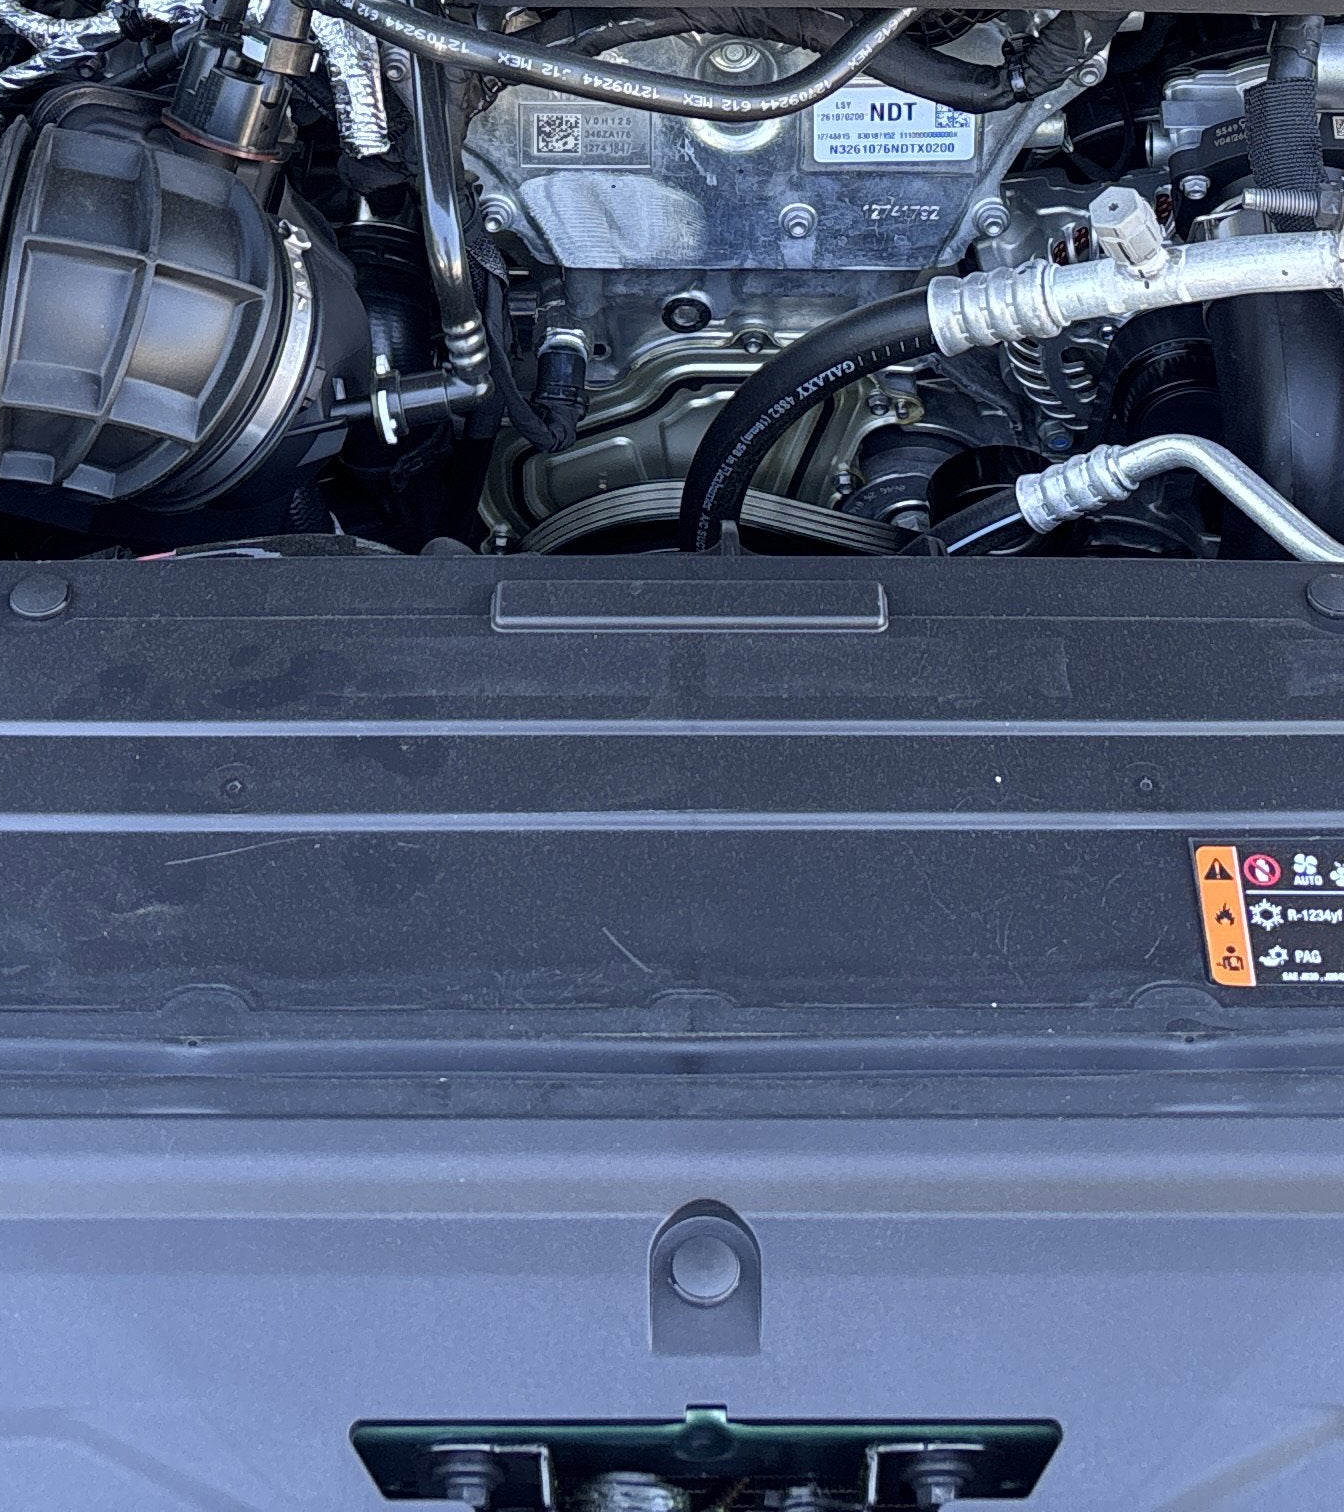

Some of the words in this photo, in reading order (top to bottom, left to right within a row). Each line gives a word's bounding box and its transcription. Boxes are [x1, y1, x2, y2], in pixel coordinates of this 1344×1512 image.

[497, 51, 532, 71] MEX
[582, 73, 659, 100] 12709244
[683, 93, 713, 109] MEX
[721, 98, 752, 112] 612
[870, 102, 918, 122] NDT
[796, 360, 855, 400] GALAXY
[1293, 874, 1324, 886] AUTO
[1287, 908, 1343, 924] R-1234yf
[1294, 949, 1322, 964] PAG
